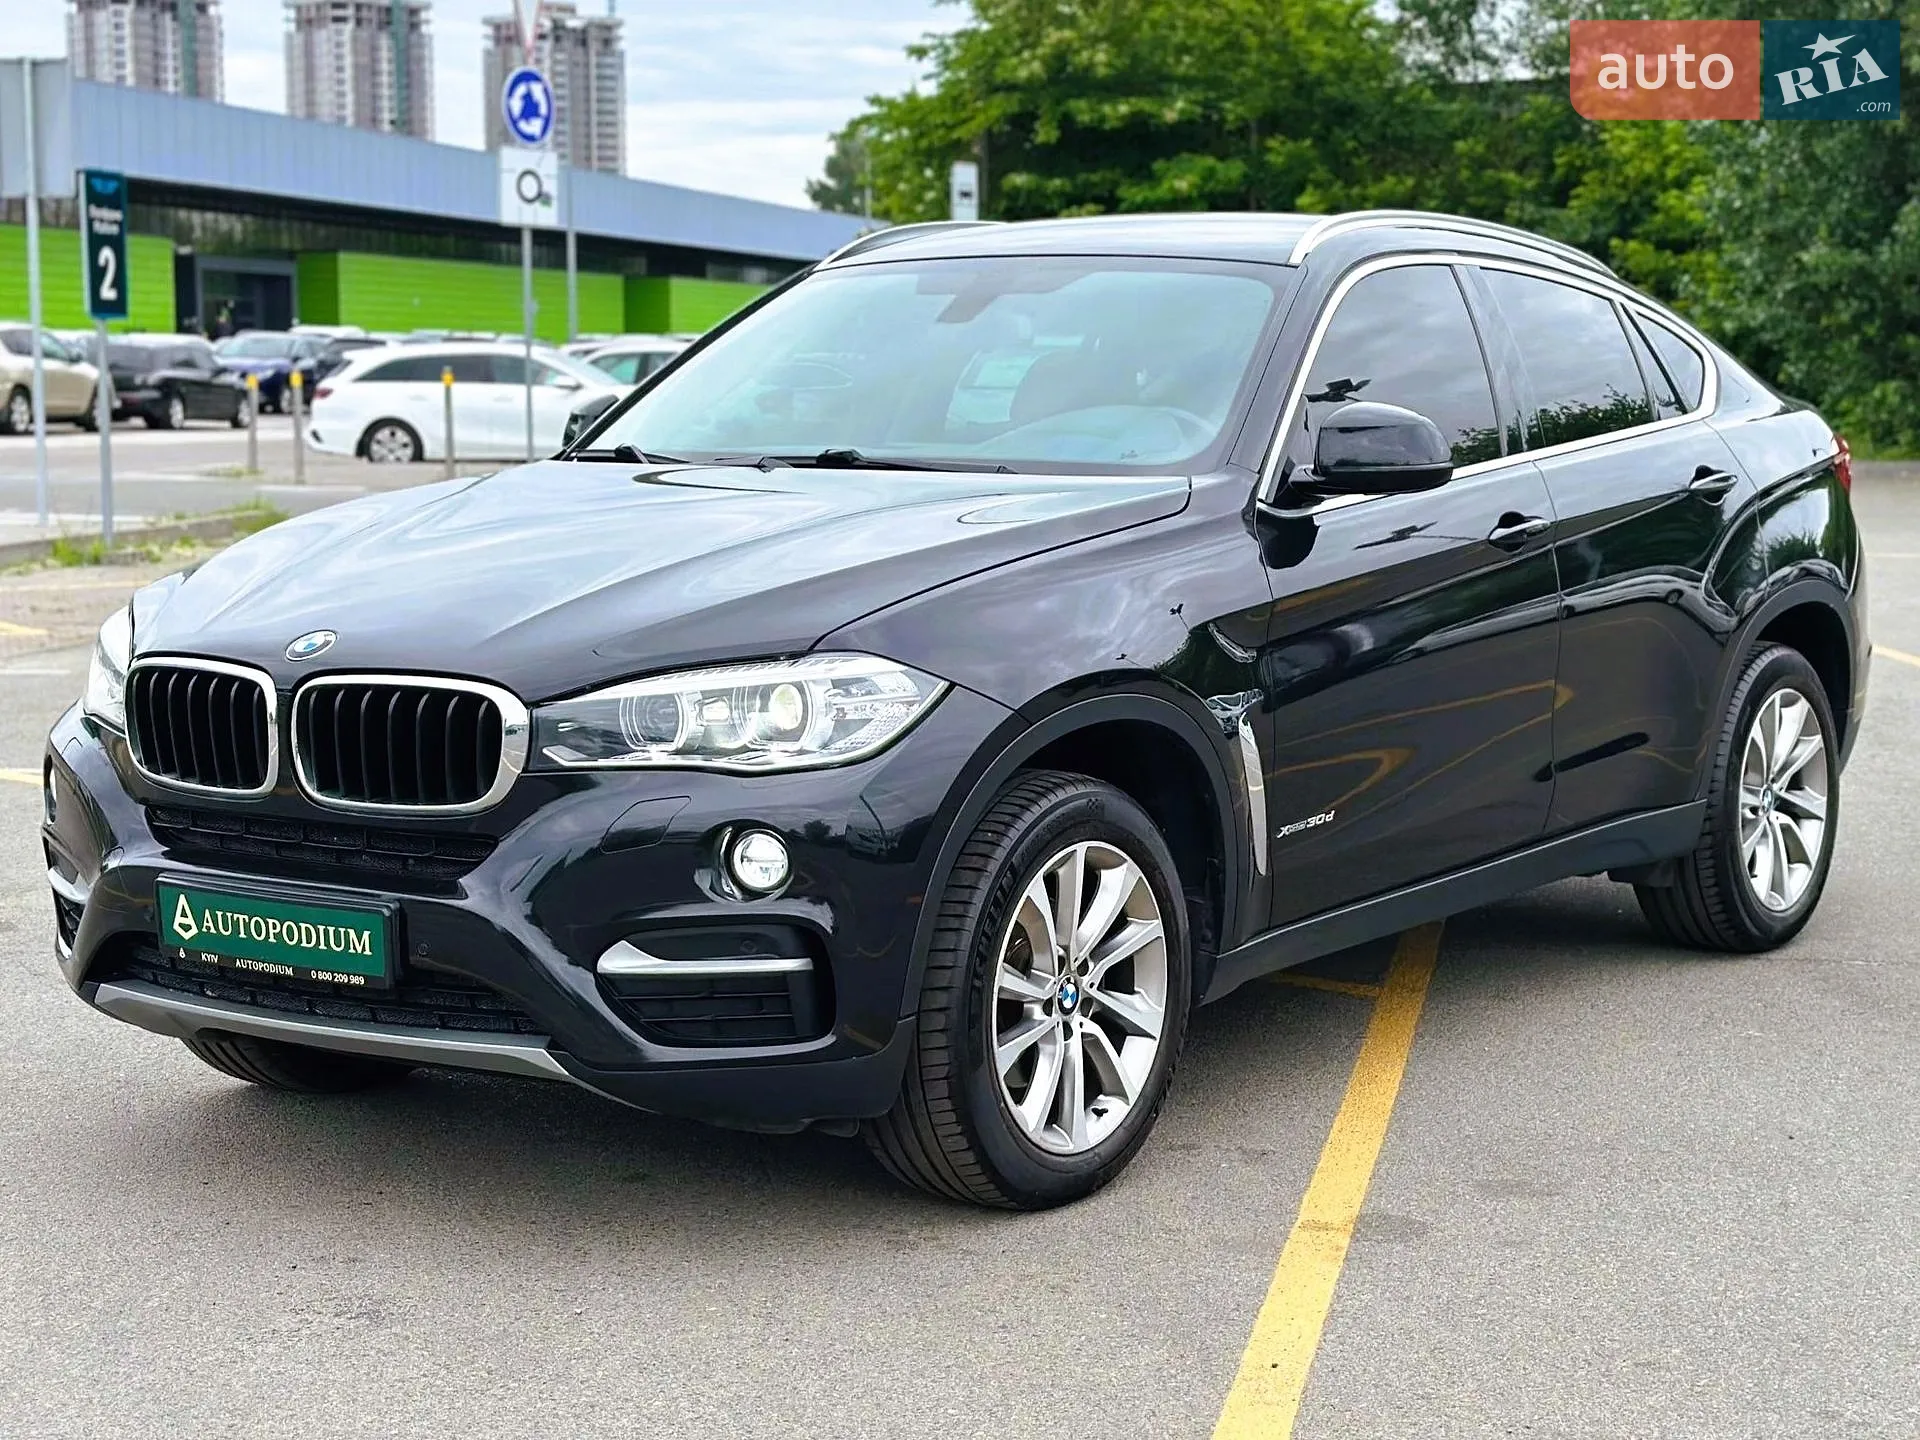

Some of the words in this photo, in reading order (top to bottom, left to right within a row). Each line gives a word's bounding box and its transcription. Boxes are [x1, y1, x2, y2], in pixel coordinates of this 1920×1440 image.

[98, 246, 118, 300] 2
[201, 908, 373, 955] AUTOPODIUM
[235, 958, 294, 976] AUTOPODIUM
[310, 969, 317, 979] 0
[317, 970, 333, 981] 800
[333, 972, 349, 983] 209
[349, 974, 365, 985] 989
